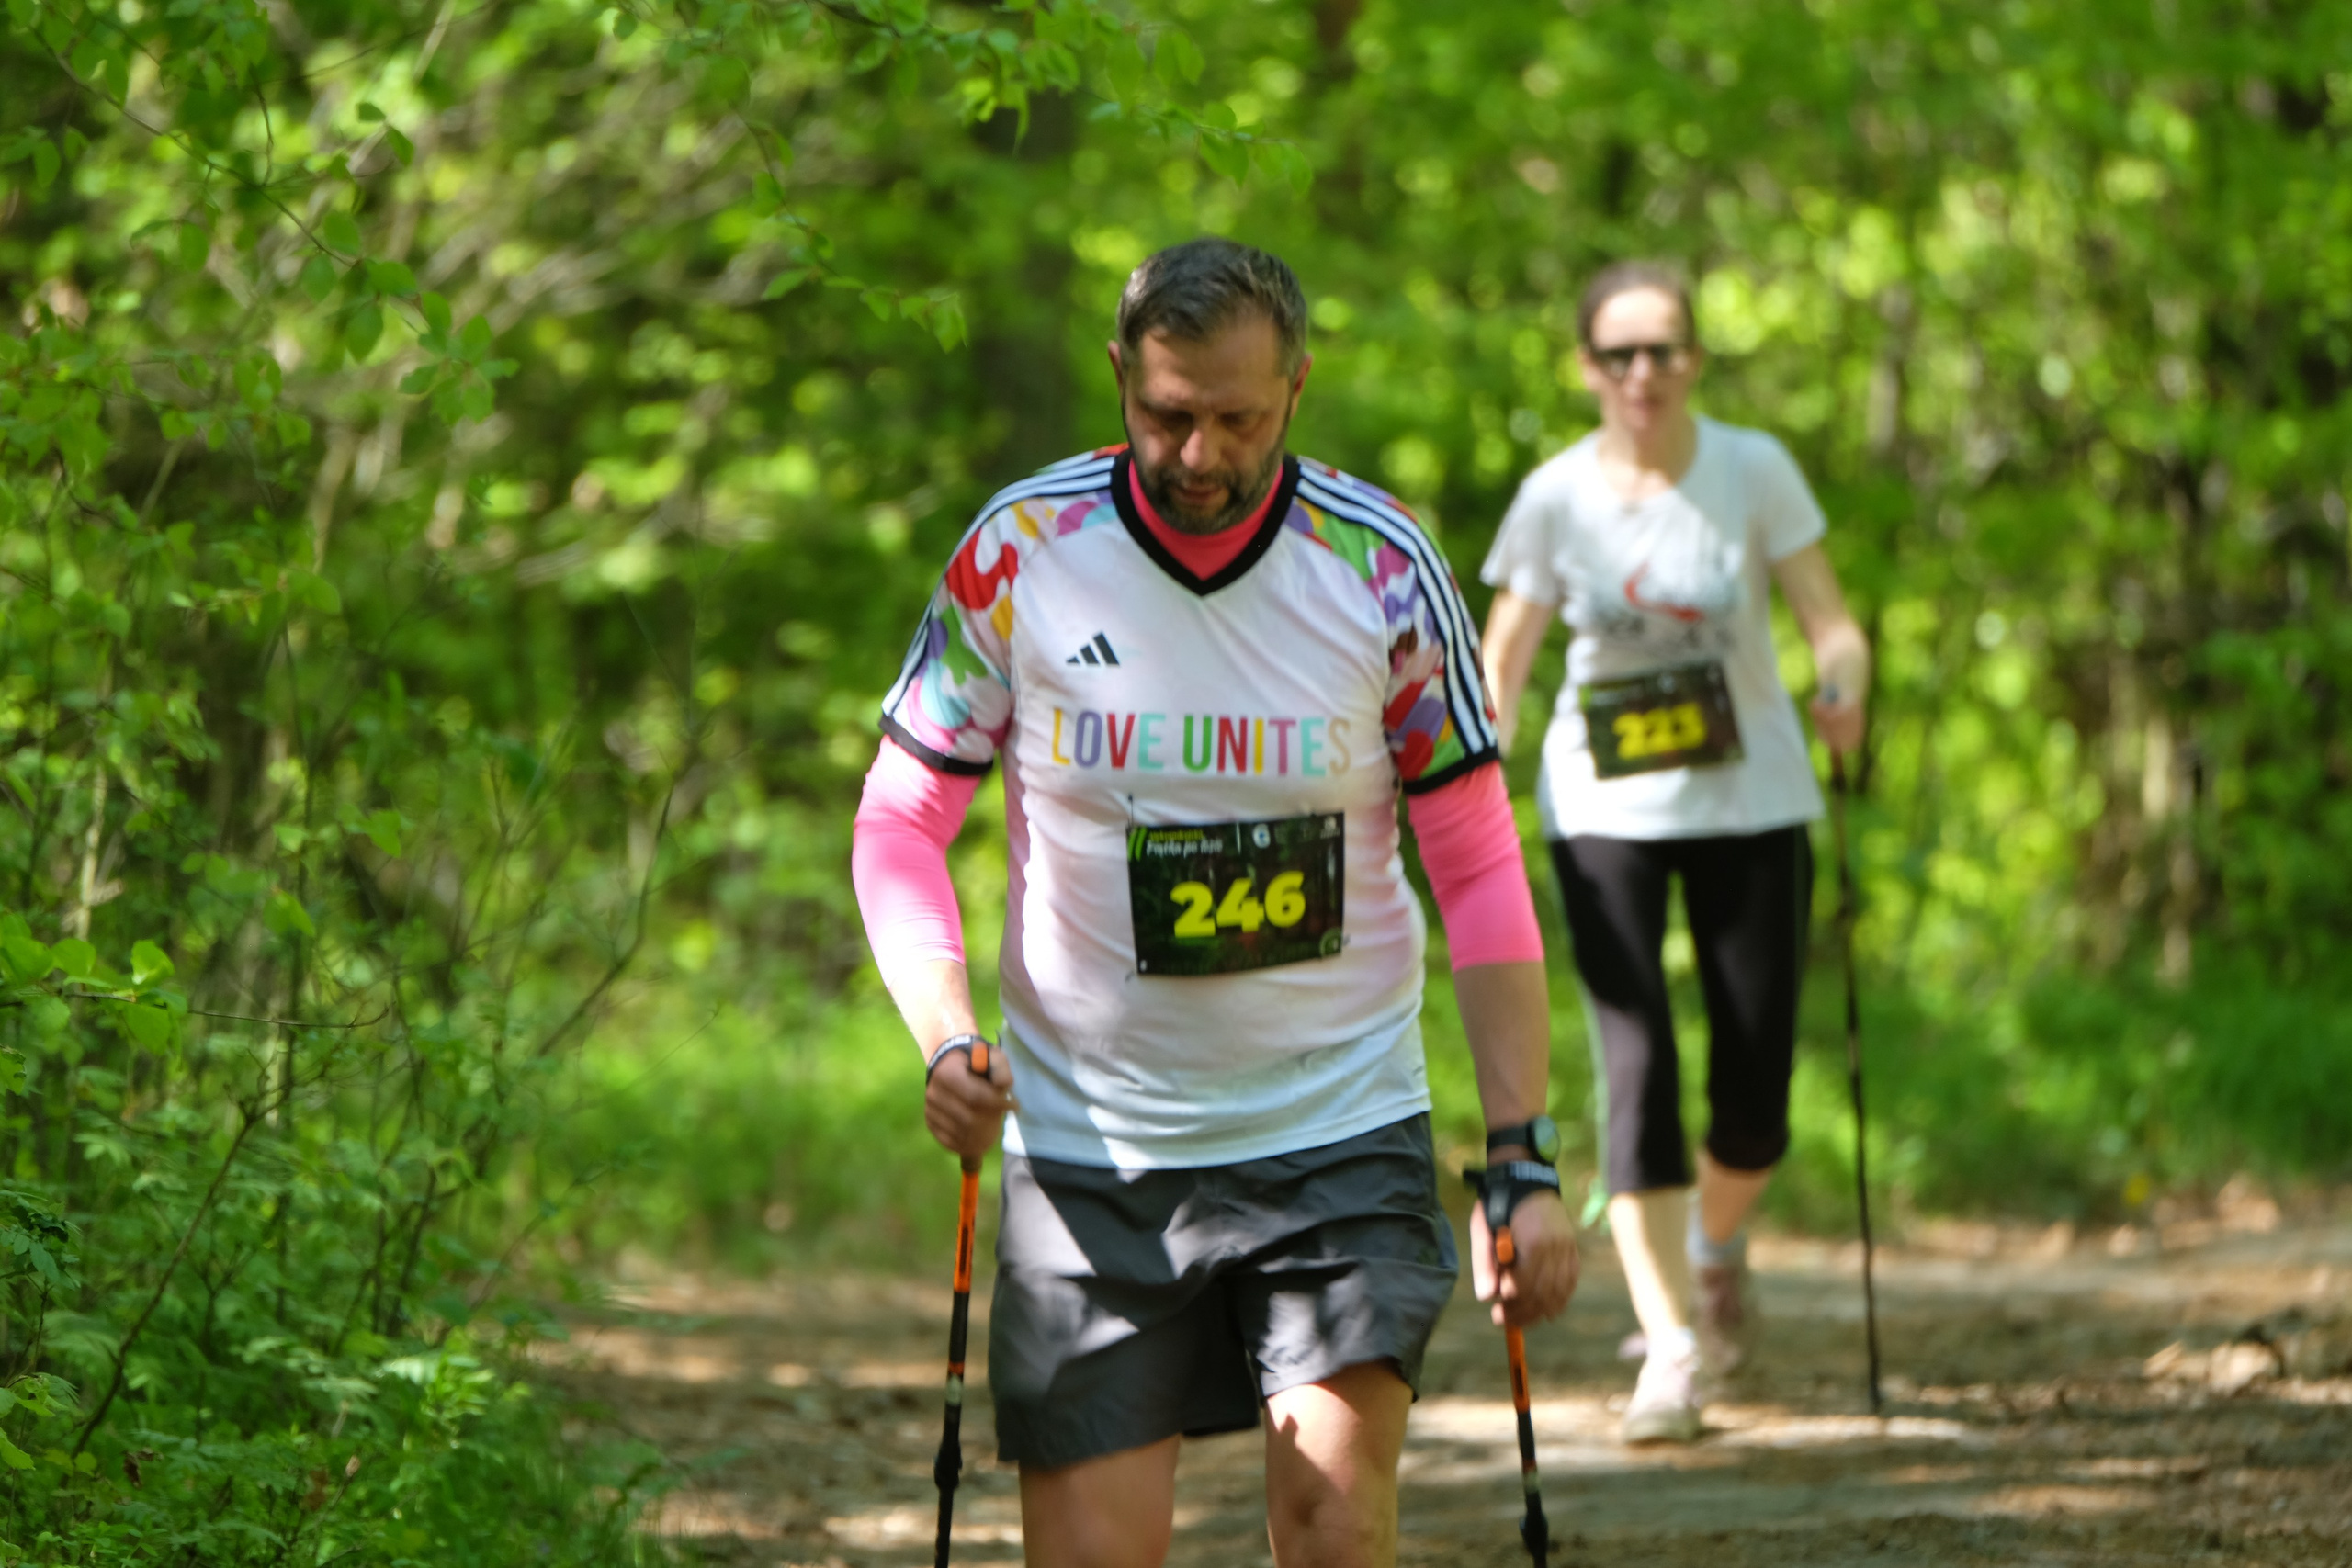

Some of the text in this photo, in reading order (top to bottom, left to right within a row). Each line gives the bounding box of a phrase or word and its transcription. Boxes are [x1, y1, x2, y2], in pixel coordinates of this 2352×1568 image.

[1051, 706, 1351, 777] LOVE UNITES
[1170, 870, 1306, 938] 246
